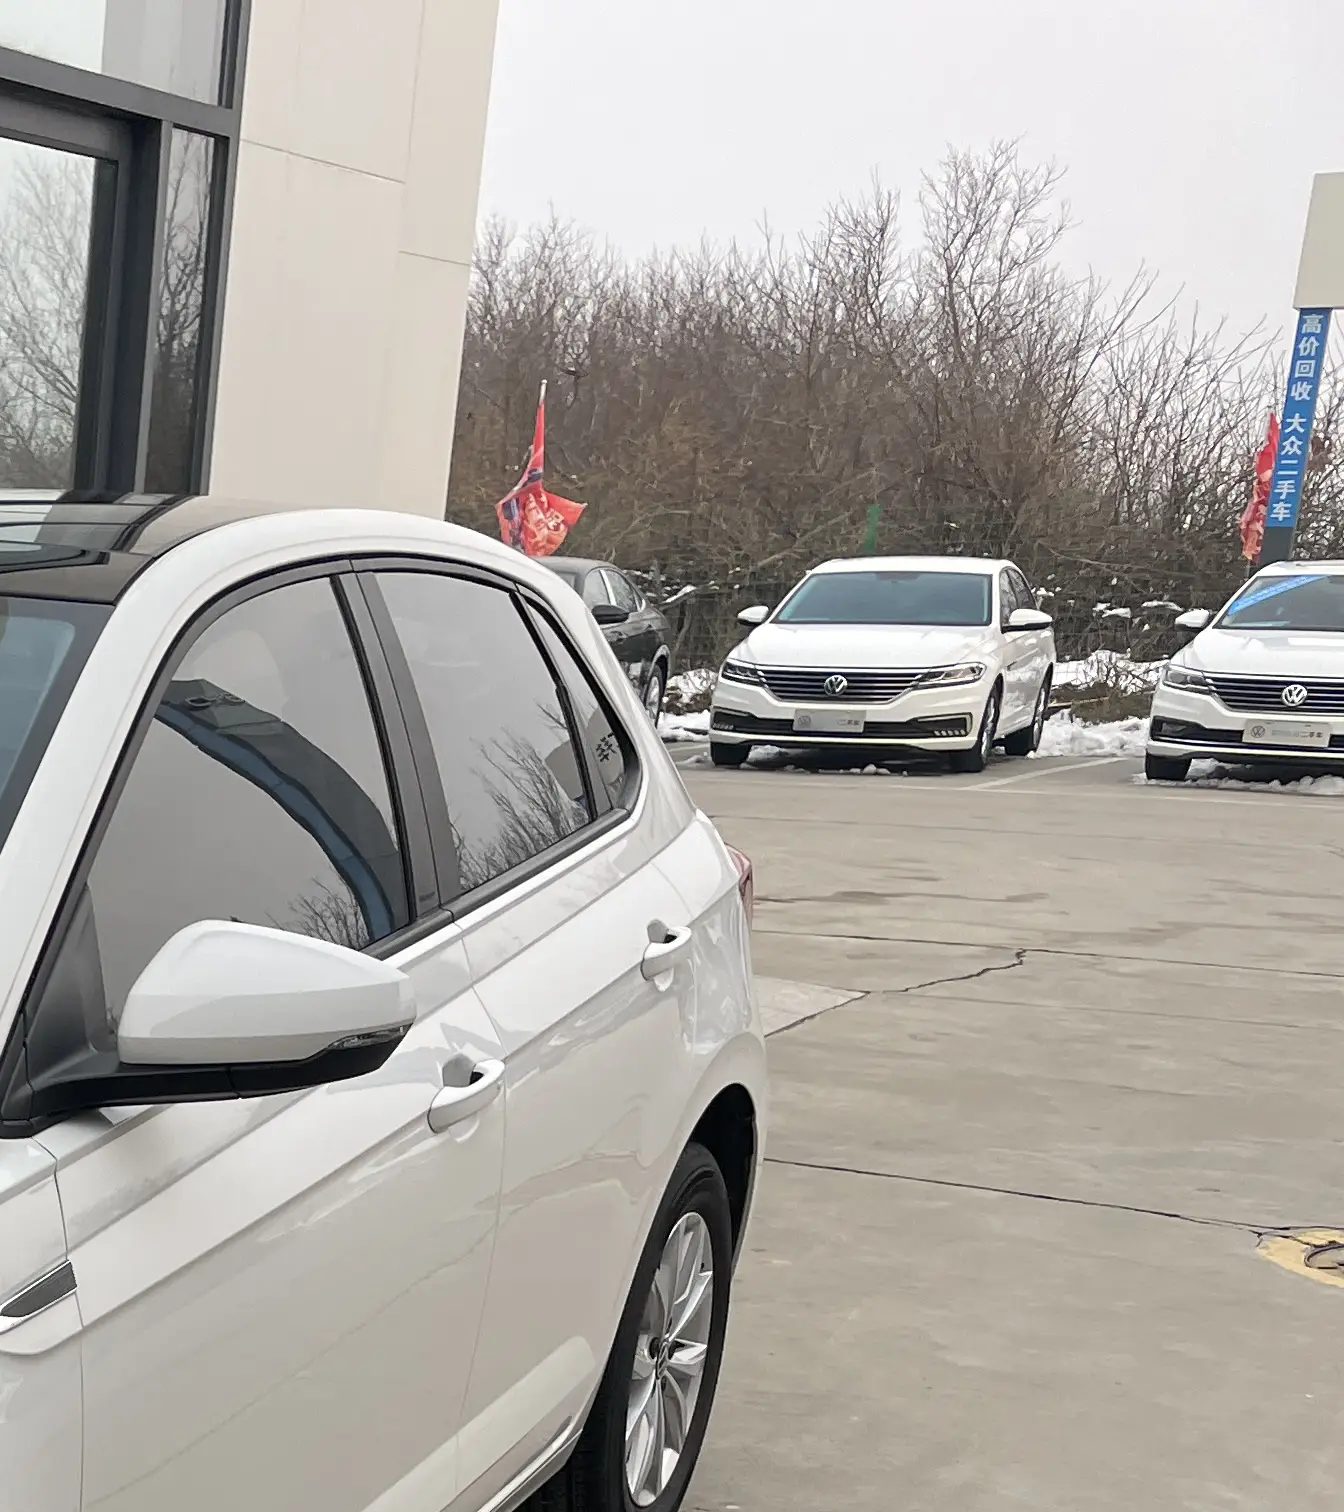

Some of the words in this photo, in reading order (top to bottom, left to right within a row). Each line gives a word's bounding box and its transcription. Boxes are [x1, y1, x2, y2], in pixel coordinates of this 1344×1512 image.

[1290, 313, 1324, 401] 高价回收
[1270, 412, 1307, 522] 大众二手车
